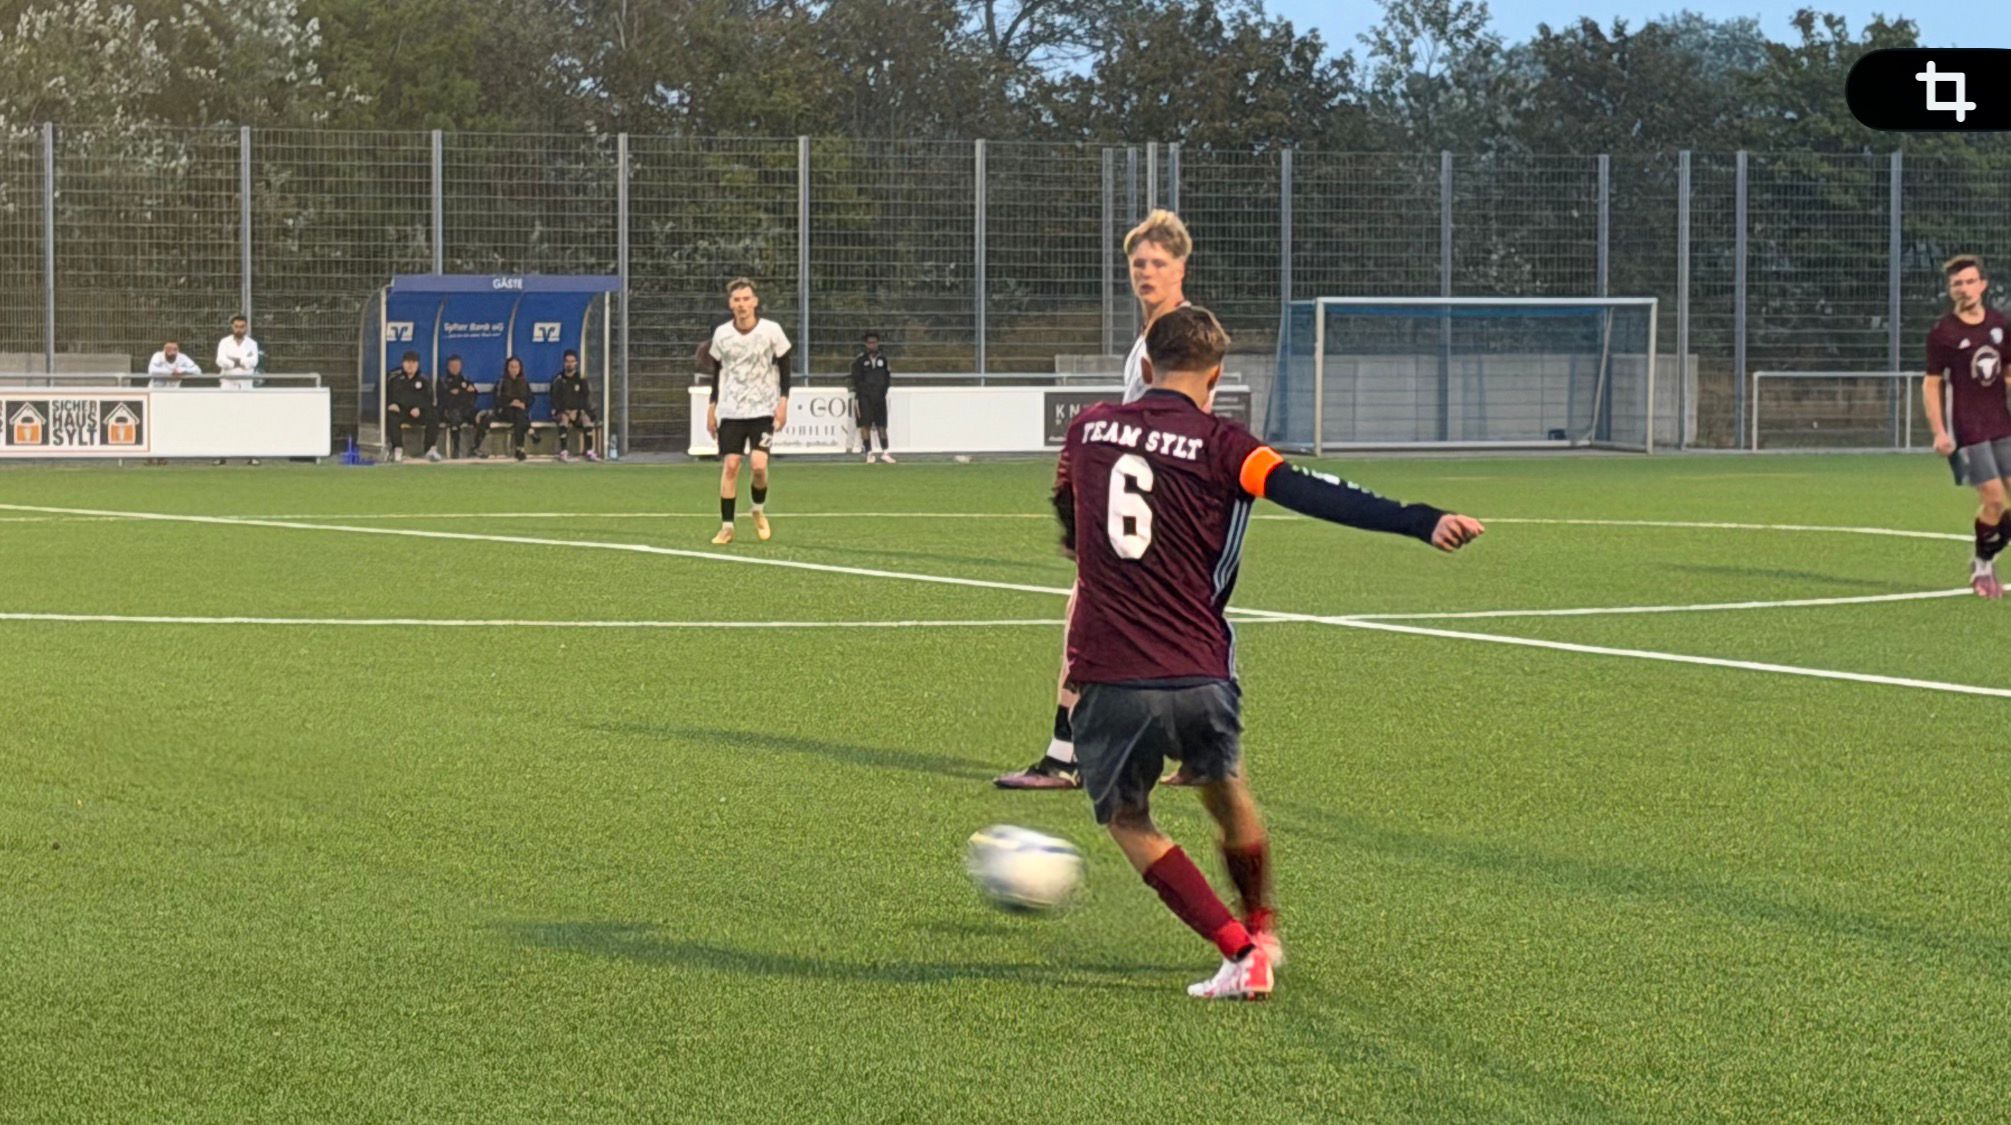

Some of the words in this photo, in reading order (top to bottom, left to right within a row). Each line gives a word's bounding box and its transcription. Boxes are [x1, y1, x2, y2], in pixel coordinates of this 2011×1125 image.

[493, 277, 523, 289] GÄSTE
[52, 400, 97, 412] SICHER
[53, 411, 97, 428] HAUS
[53, 428, 97, 446] SYLT
[1082, 421, 1142, 447] TEAM
[1145, 431, 1203, 460] SYLT
[1108, 454, 1153, 559] 6
